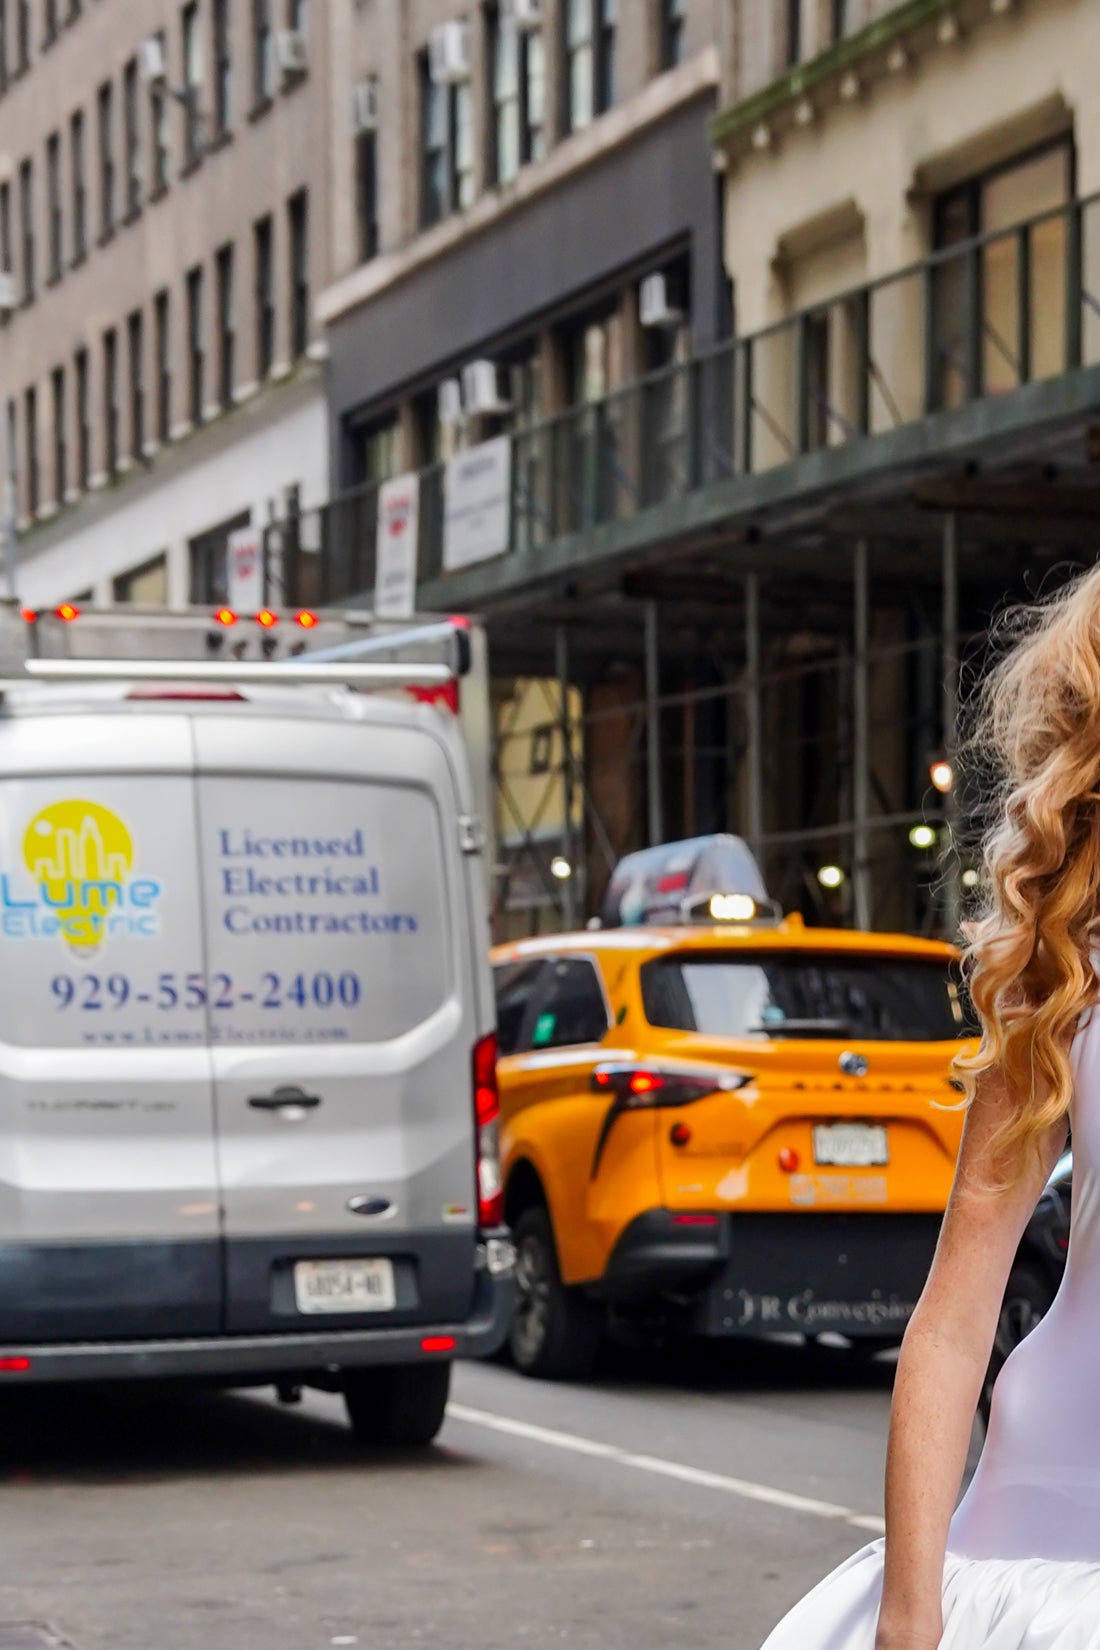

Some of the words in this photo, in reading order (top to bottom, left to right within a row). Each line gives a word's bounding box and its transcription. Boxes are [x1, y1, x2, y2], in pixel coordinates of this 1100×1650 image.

[219, 828, 365, 857] Licensed
[1, 873, 161, 908] Lume
[221, 865, 380, 896] Electrical
[2, 909, 159, 937] Electric
[222, 904, 419, 935] Contractors
[50, 971, 361, 1011] 929-552-2400
